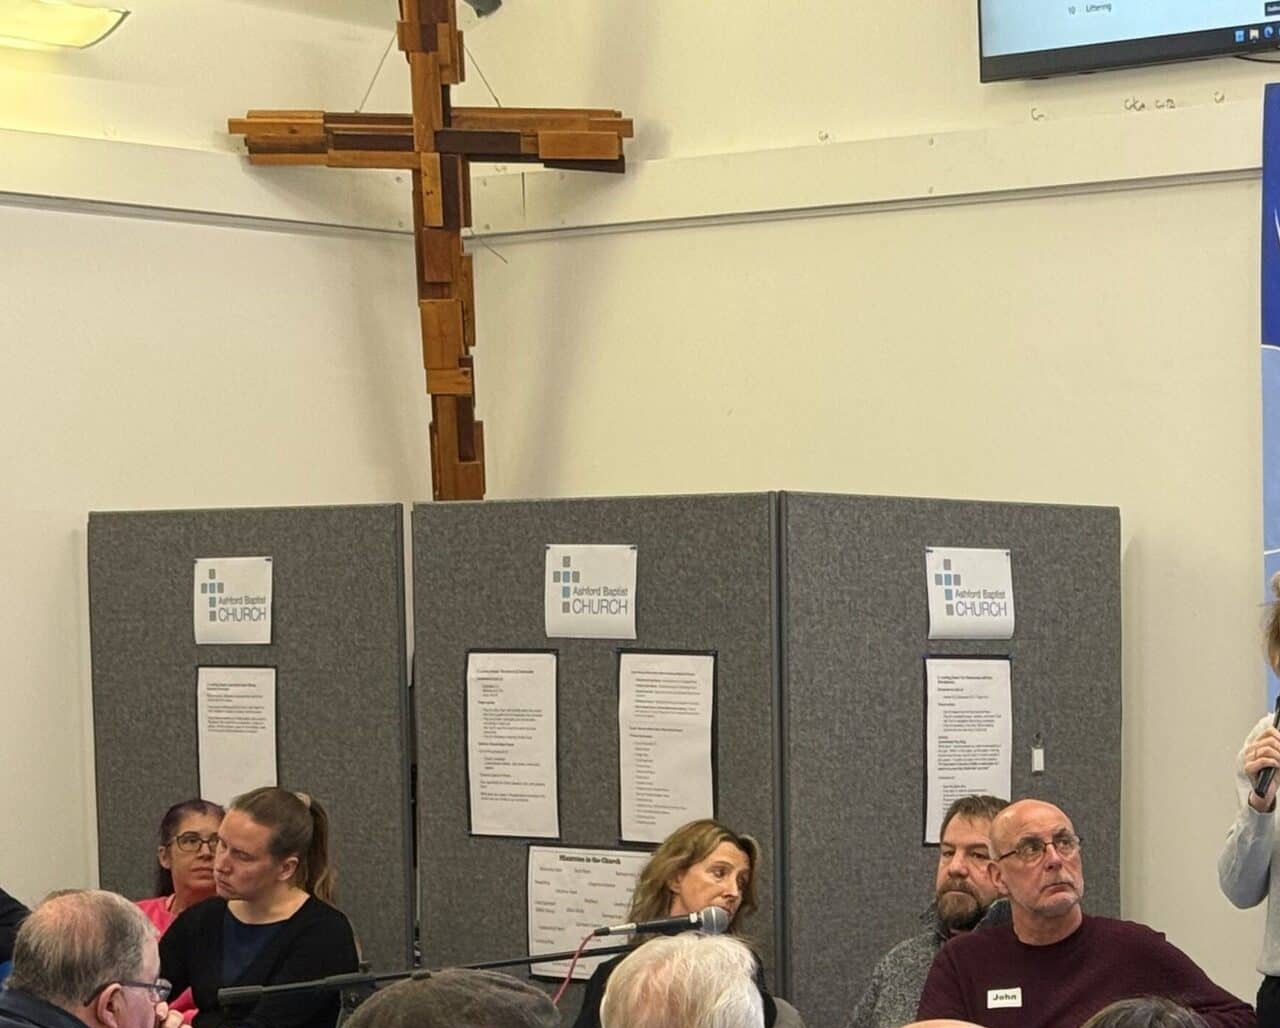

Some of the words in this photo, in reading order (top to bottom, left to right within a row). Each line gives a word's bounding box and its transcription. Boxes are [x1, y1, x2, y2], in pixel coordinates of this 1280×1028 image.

[573, 586, 601, 596] Ashford
[603, 586, 628, 597] Baptist
[955, 589, 981, 599] Ashford
[983, 589, 1006, 600] Baptist
[218, 596, 243, 605] Ashford
[572, 598, 628, 615] CHURCH
[955, 601, 1007, 617] CHURCH
[218, 607, 266, 622] CHURCH
[993, 993, 1017, 1001] John
